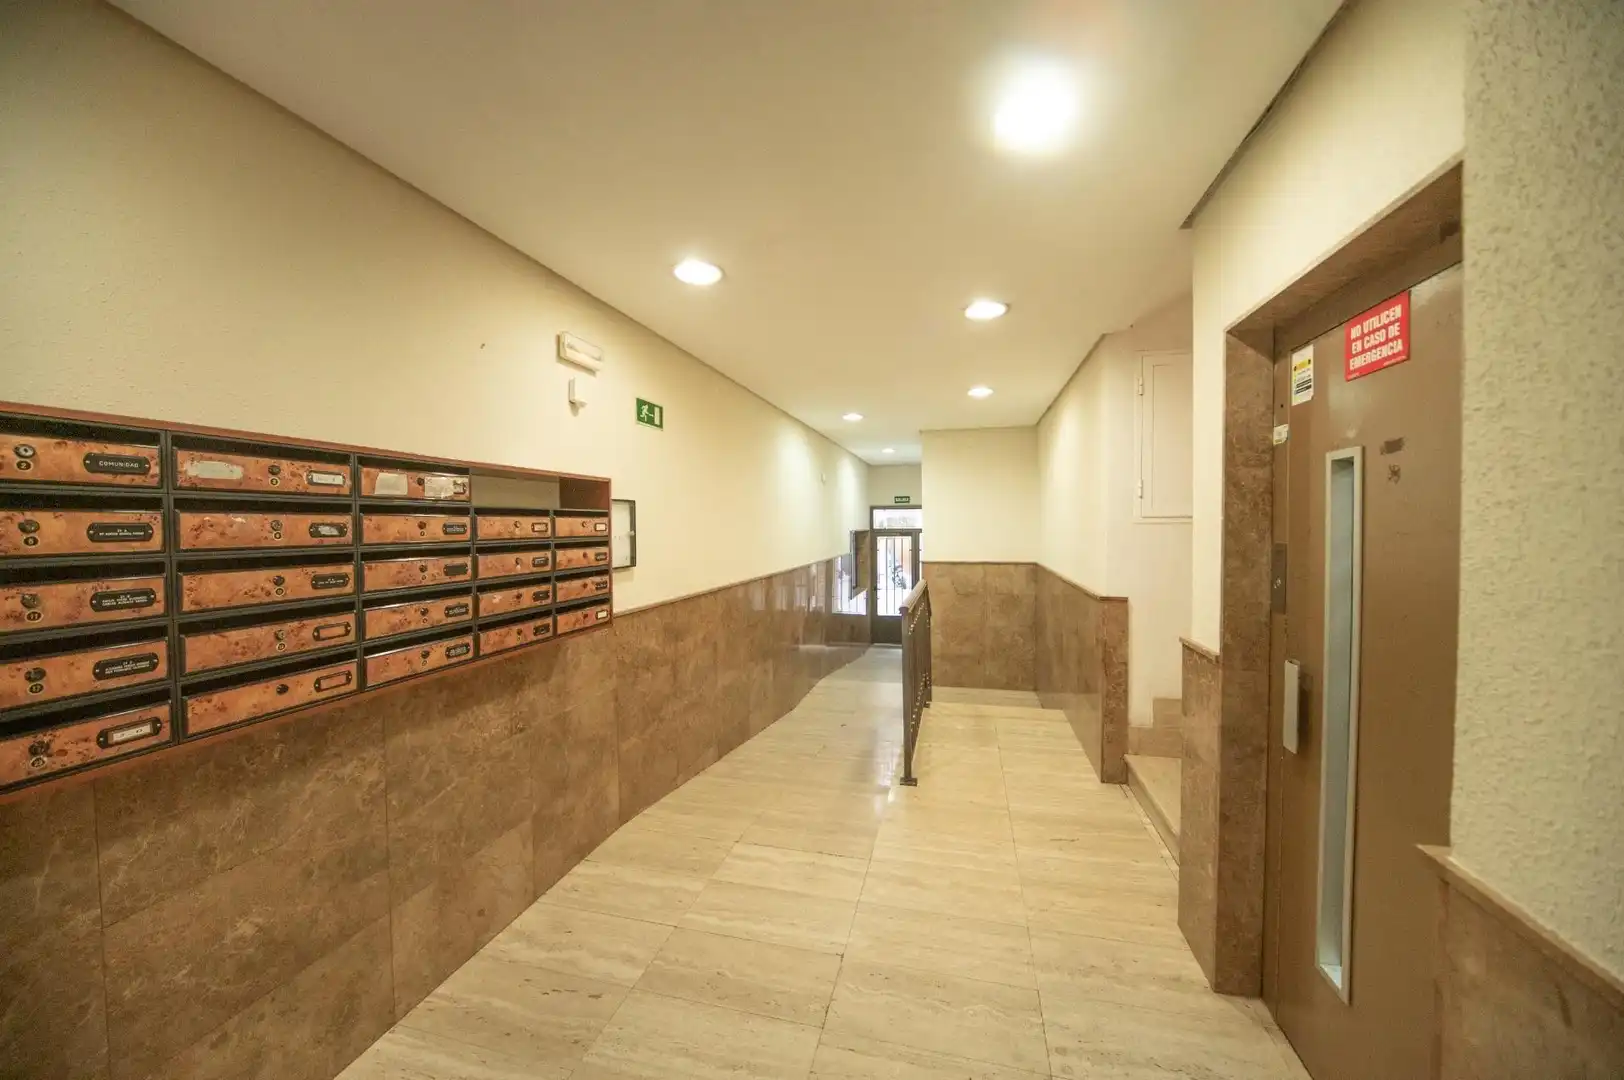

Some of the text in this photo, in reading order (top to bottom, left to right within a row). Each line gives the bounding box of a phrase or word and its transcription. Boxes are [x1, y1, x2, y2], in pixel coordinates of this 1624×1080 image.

[1350, 304, 1402, 340] NO UTILICEN
[1351, 322, 1401, 354] EN CASO DE
[1350, 339, 1403, 370] EMERGENCIA
[98, 460, 139, 468] COMUNIDAD
